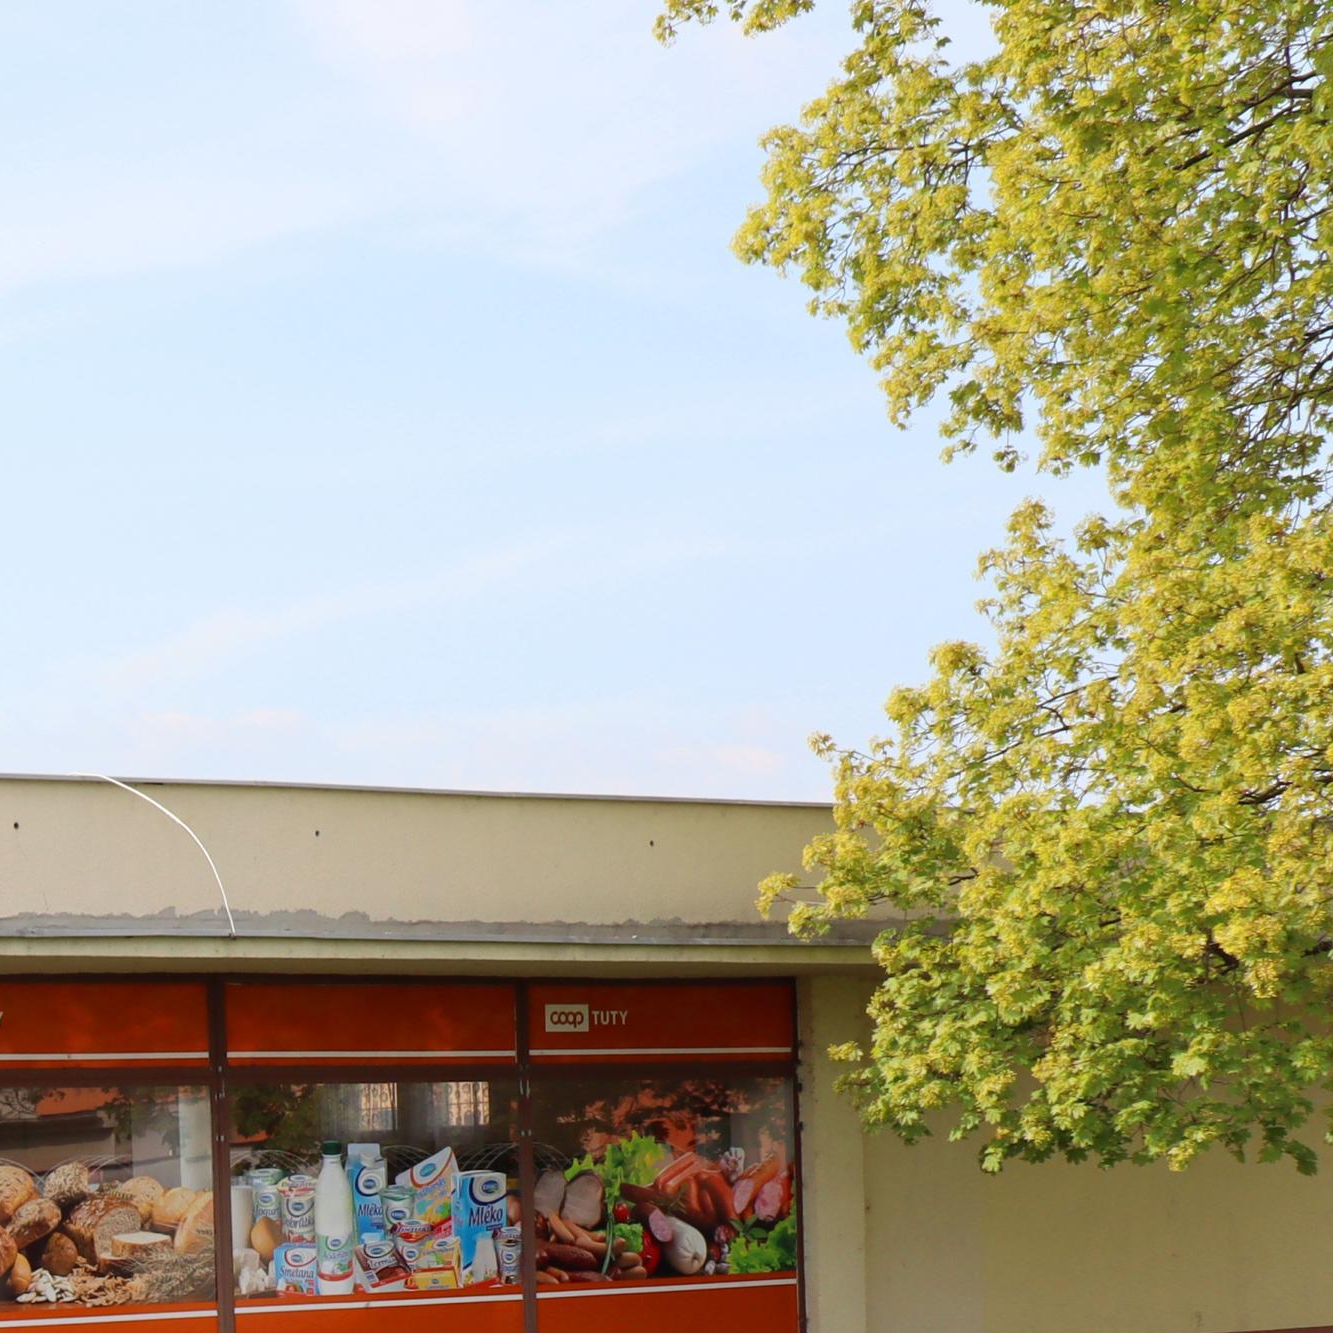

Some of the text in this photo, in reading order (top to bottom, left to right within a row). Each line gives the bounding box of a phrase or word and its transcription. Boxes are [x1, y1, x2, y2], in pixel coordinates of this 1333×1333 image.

[550, 1010, 628, 1028] coop TUTY
[469, 1204, 503, 1226] Mléko
[280, 1266, 314, 1279] Smetana
